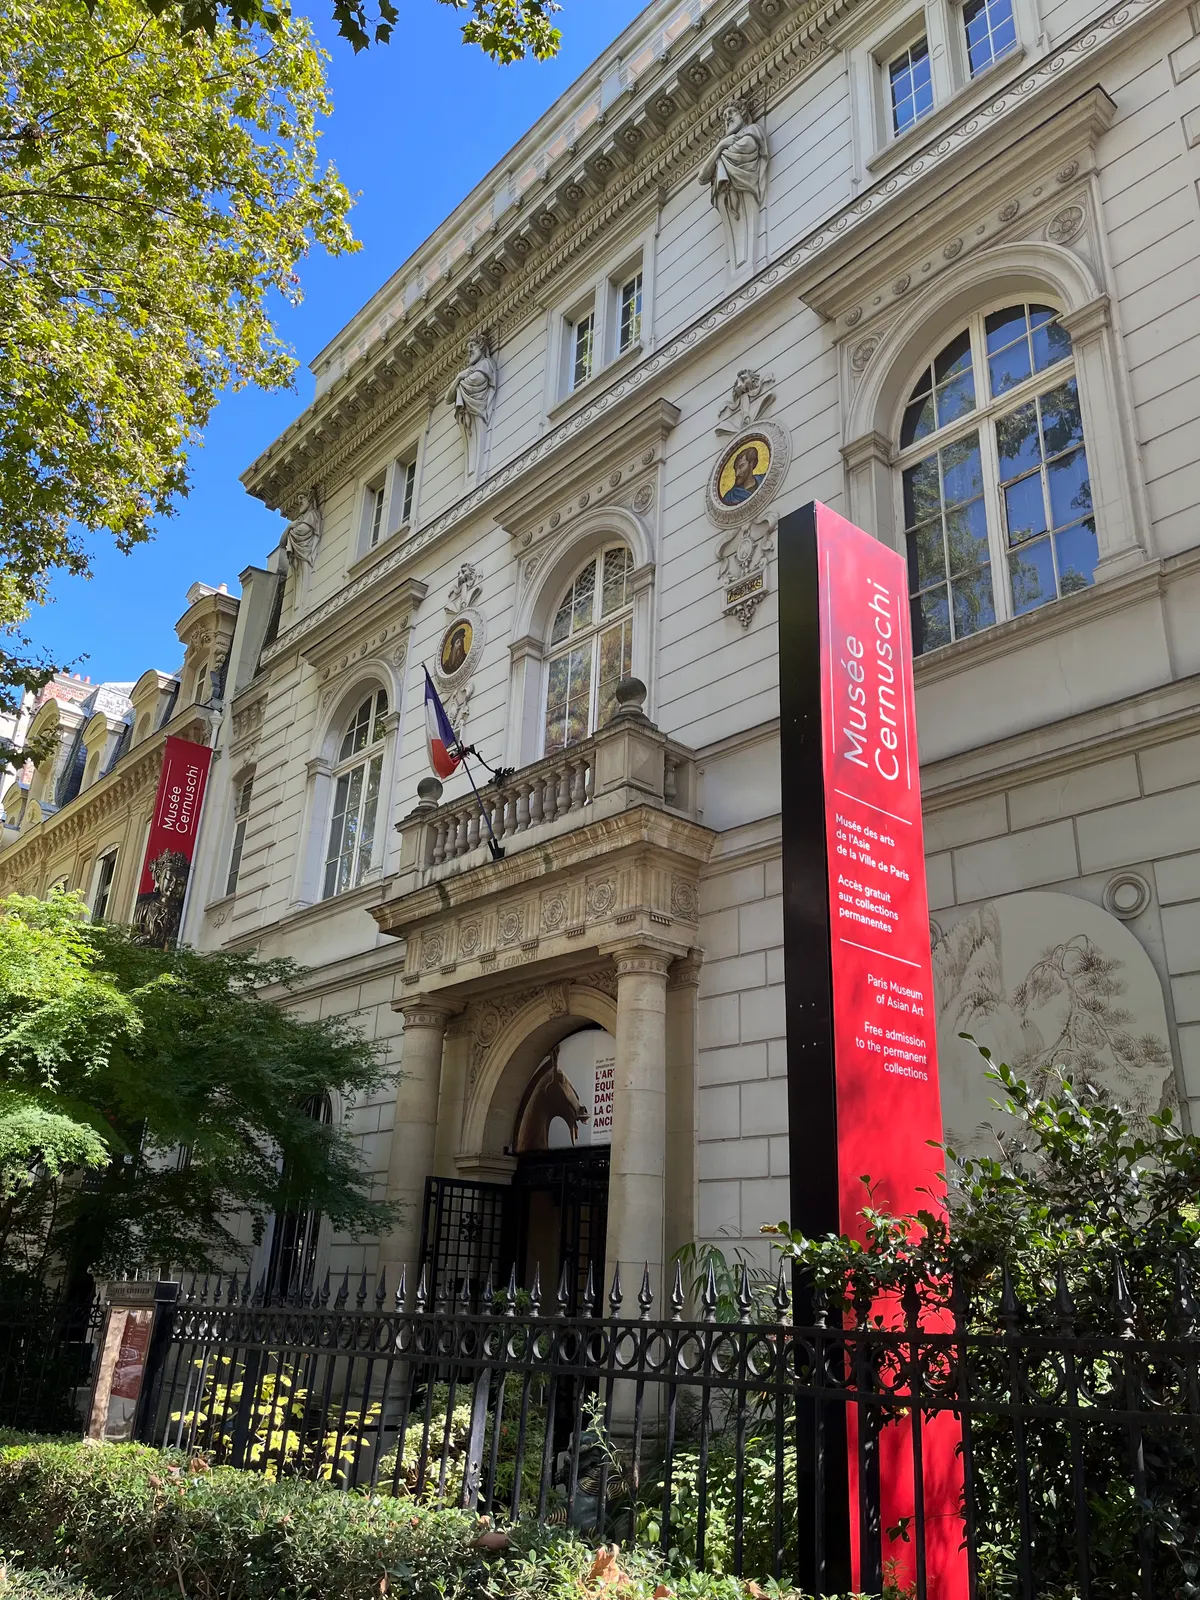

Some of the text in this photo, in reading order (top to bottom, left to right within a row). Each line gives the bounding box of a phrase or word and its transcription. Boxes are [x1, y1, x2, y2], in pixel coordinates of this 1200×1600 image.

[867, 578, 899, 781] Cernuschi
[841, 636, 868, 768] Musée
[163, 786, 181, 831] Musée
[176, 764, 199, 834] Cernuschi
[836, 813, 895, 846] Musée des arts
[836, 829, 870, 851] de l'Asie
[836, 844, 910, 881] de la Ville de Paris
[838, 874, 891, 903] Accès gratuit
[839, 892, 898, 921] aux collections
[840, 907, 892, 933] permanentes
[868, 974, 923, 1000] Paris Museum
[876, 994, 924, 1016] of Asian Art
[864, 1021, 926, 1048] Free admission
[856, 1038, 927, 1065] to the permanent
[884, 1060, 928, 1081] collections
[594, 1106, 603, 1115] LA
